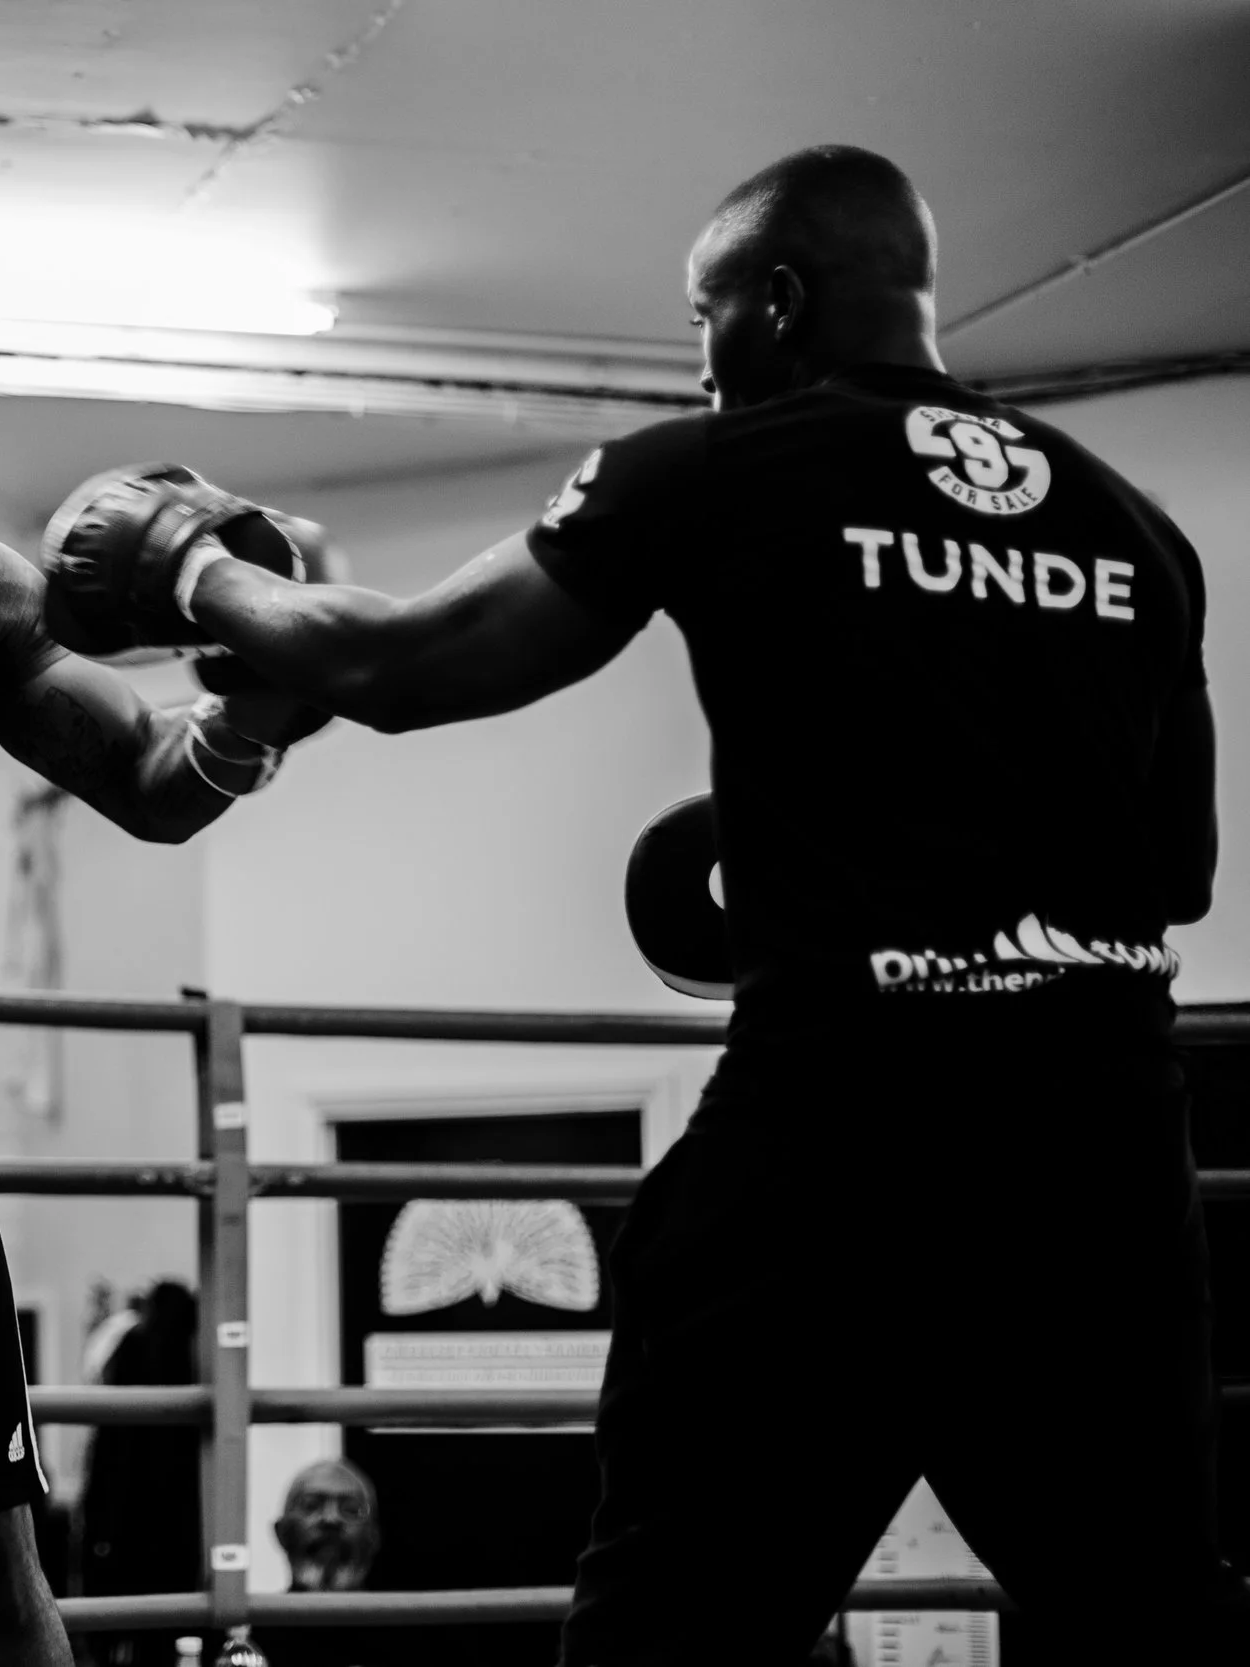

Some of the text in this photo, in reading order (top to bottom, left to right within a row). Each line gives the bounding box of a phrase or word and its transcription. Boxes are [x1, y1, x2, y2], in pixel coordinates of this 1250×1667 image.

[938, 473, 1038, 511] FOR SALE
[843, 526, 1135, 621] TUNDE
